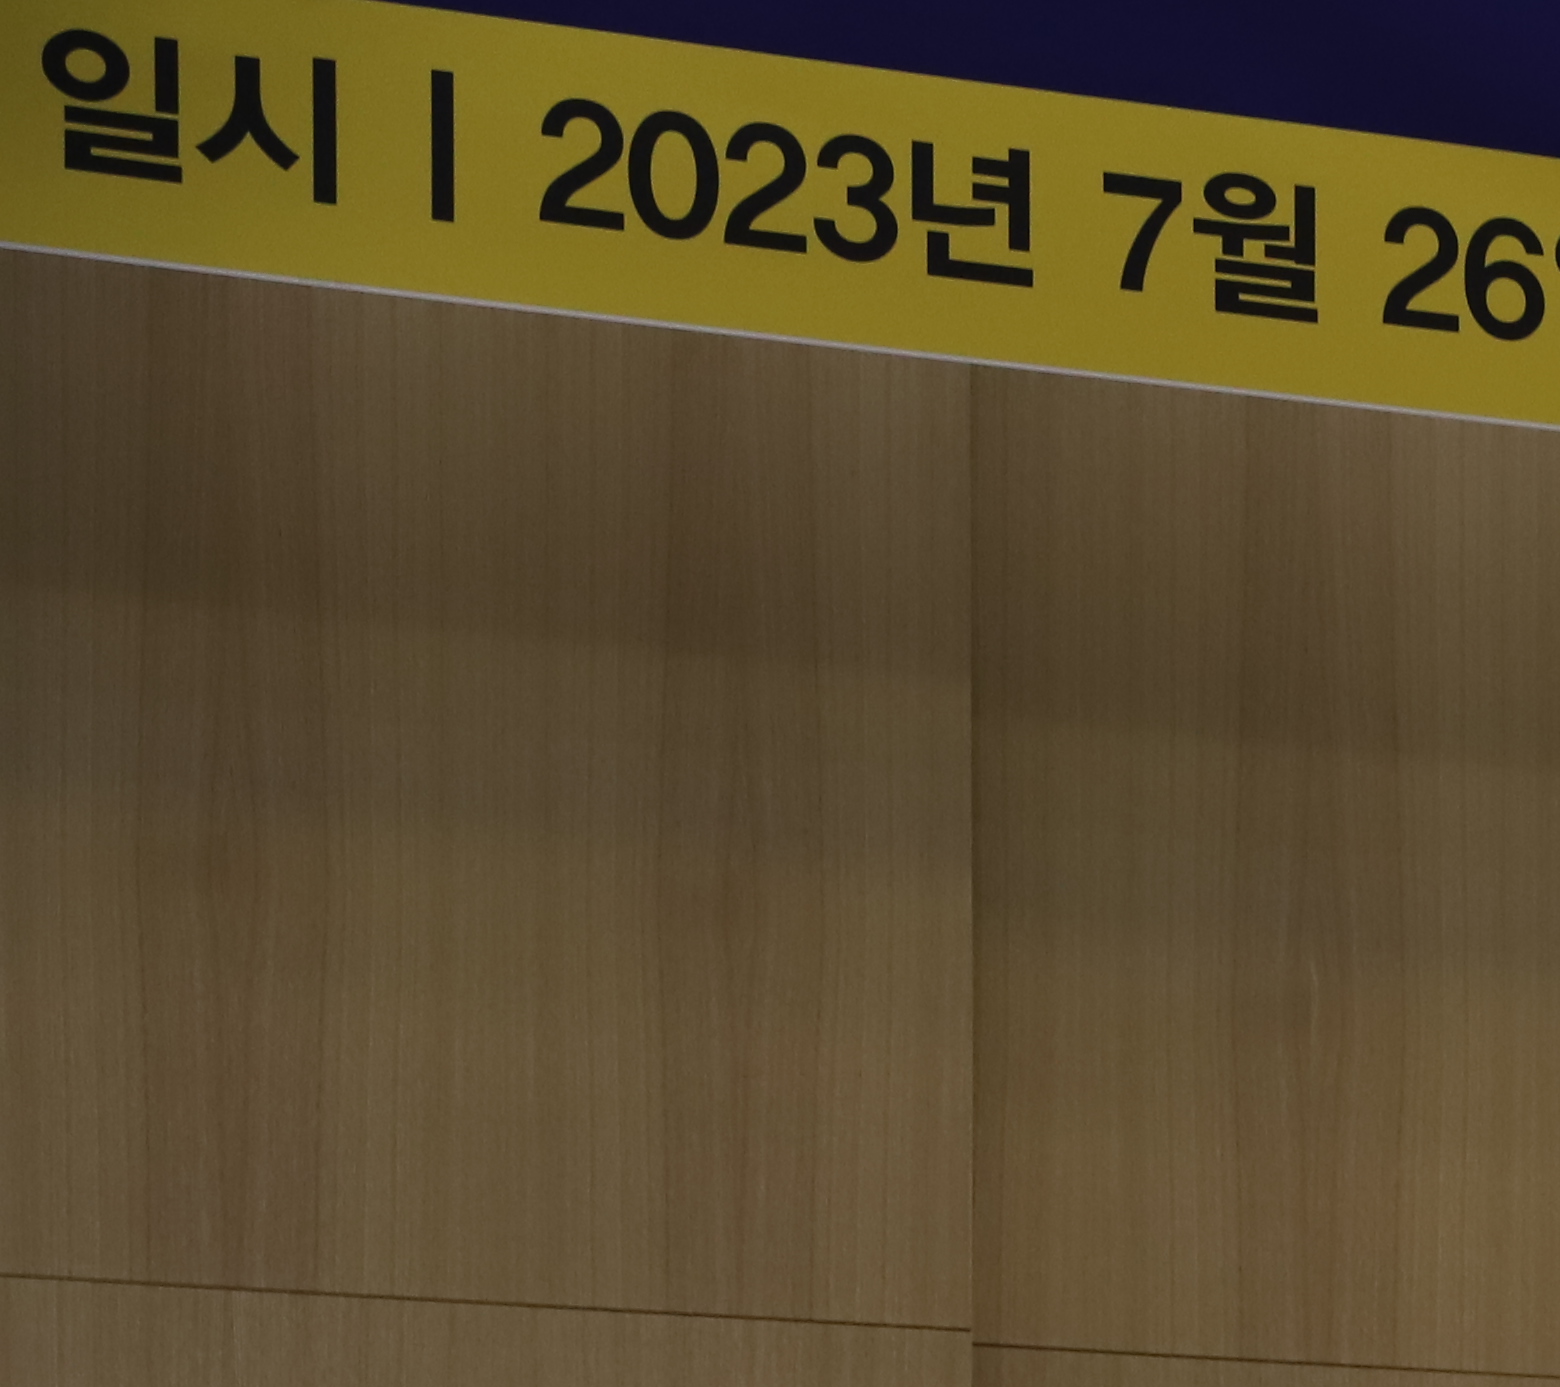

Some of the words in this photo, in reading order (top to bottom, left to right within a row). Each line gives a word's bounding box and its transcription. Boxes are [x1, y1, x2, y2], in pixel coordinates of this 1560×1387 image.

[41, 28, 337, 205] 일시
[539, 98, 1034, 288] 2023년
[1102, 171, 1319, 324] 7월
